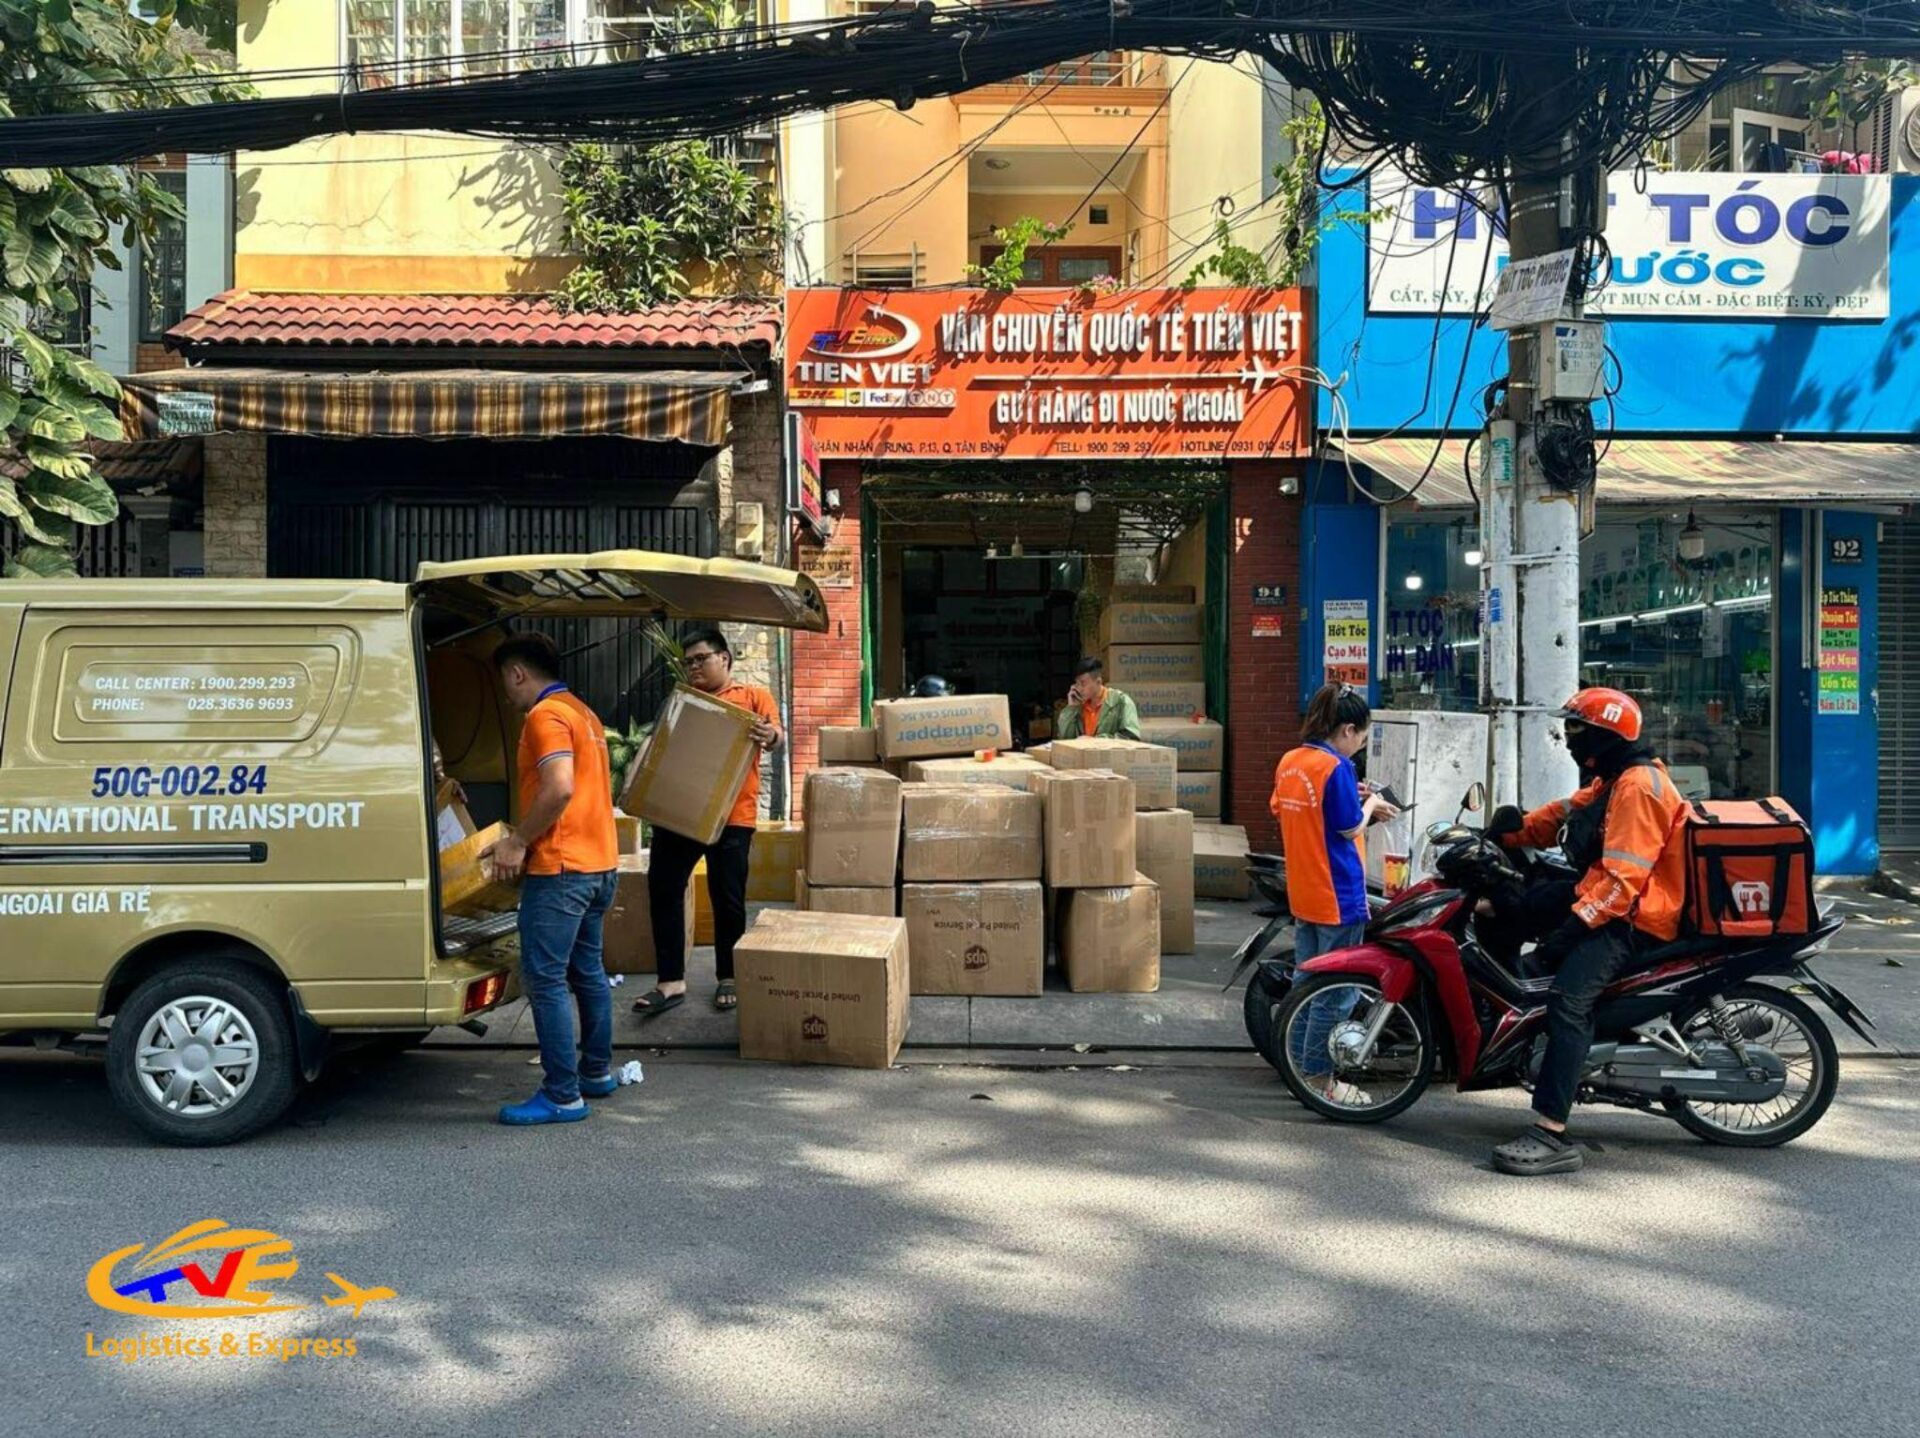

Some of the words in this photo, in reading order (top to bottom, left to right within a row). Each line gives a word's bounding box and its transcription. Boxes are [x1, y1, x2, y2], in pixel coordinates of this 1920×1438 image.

[1650, 180, 1851, 246] TÓC
[941, 305, 987, 359] VẬN
[992, 302, 1084, 352] CHUYỂN
[1089, 302, 1151, 357] QUỐC
[1158, 304, 1186, 352] TẾ
[1192, 302, 1245, 352] TIẾN
[1251, 304, 1303, 359] VIỆT
[796, 390, 837, 399] DHL
[996, 380, 1034, 424] GỬI
[1038, 385, 1095, 424] HÀNG
[1098, 391, 1118, 424] ĐI
[1123, 382, 1178, 424] NƯỚC
[1182, 384, 1245, 423] NGOÀI
[1087, 442, 1109, 453] 1900
[1112, 442, 1131, 453] 299
[1231, 441, 1254, 452] 0931
[1833, 540, 1859, 557] 92
[1257, 587, 1281, 597] 94
[1349, 624, 1366, 637] Tóc
[1327, 646, 1346, 660] Cạo
[95, 677, 130, 690] CALL
[135, 677, 196, 690] CENTER:
[200, 677, 296, 690] 1900.299.293
[92, 698, 145, 711] PHONE:
[187, 697, 255, 711] 028.3636
[258, 697, 294, 710] 9693
[895, 721, 1000, 744] Catnapper
[91, 764, 268, 797] 50G-002.84
[188, 802, 365, 831] TRANSPORT
[71, 888, 110, 914] GIÁ
[933, 921, 964, 931] Service
[993, 921, 1020, 931] United
[767, 988, 799, 1000] Service
[802, 991, 829, 1001] Parcel
[831, 992, 861, 1003] United
